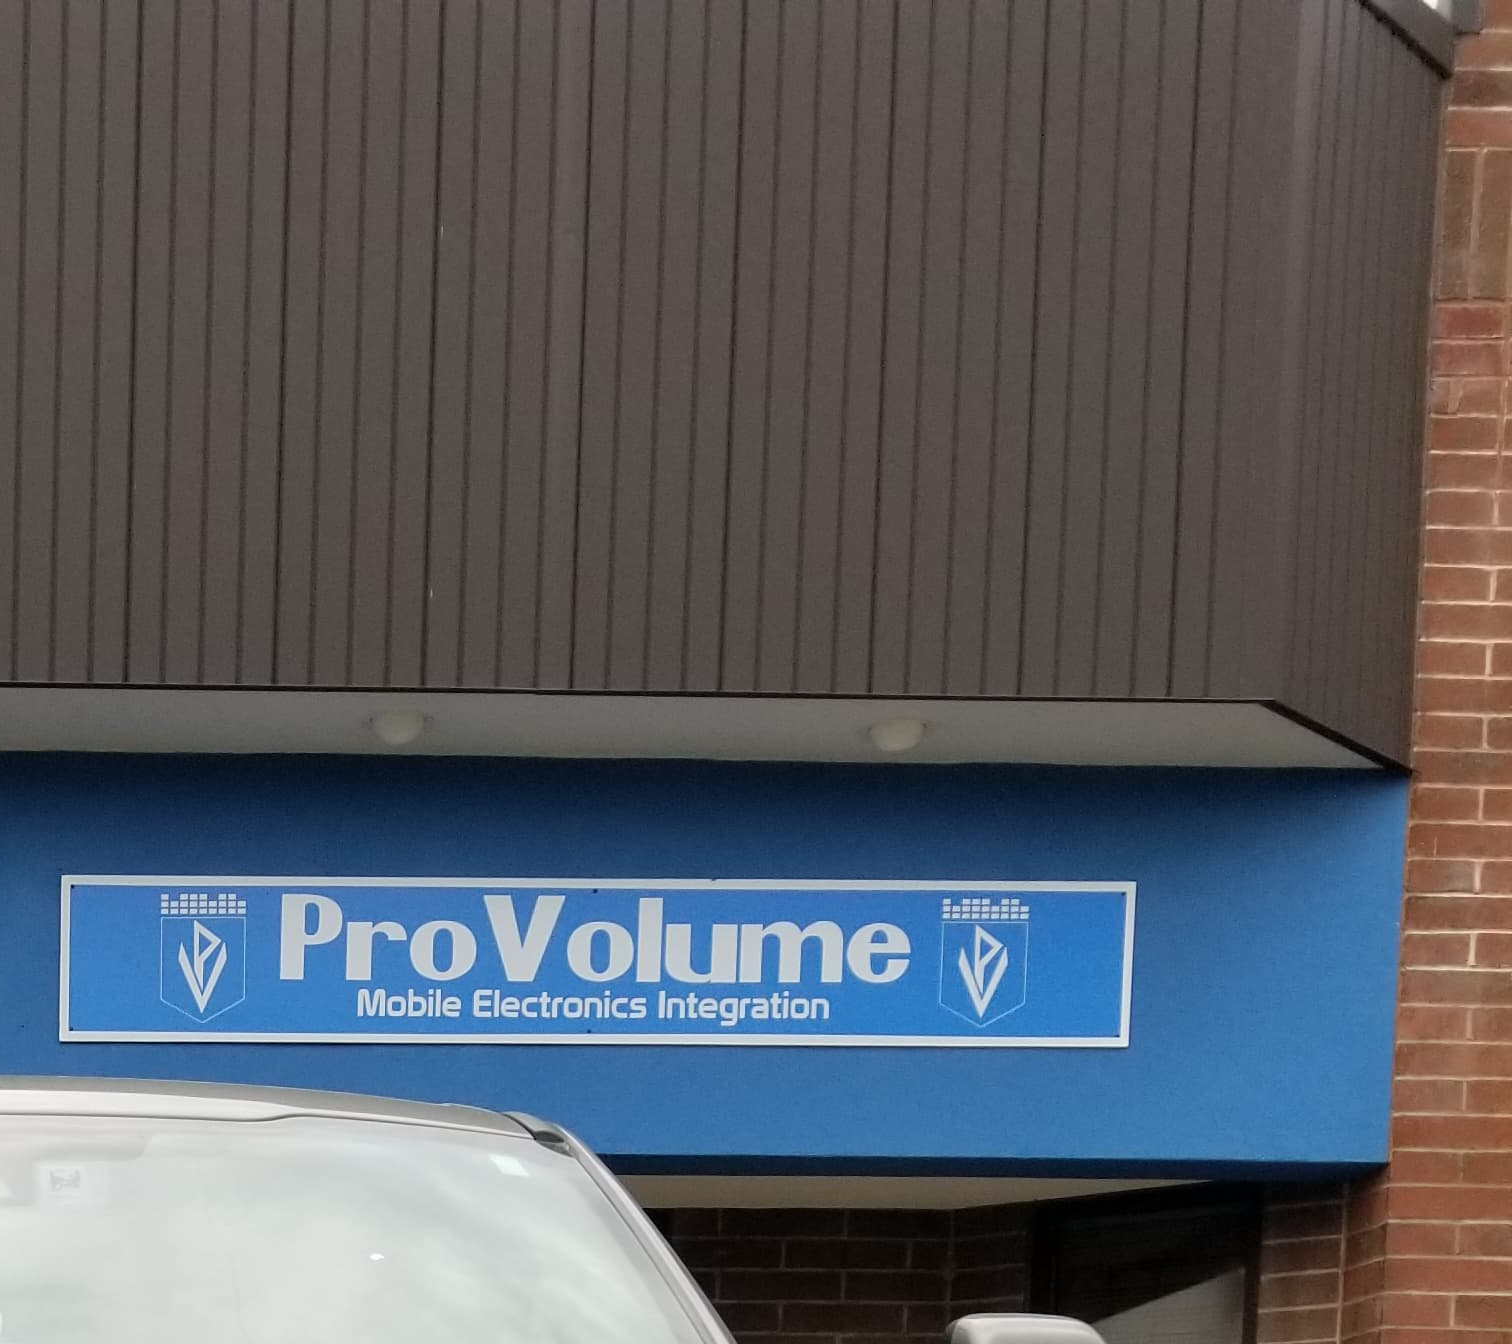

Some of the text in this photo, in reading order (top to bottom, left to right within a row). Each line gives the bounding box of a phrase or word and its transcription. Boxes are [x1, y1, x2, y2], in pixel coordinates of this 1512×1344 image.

[279, 893, 911, 984] ProVolume
[357, 988, 830, 1027] Mobile Electronics Integration
